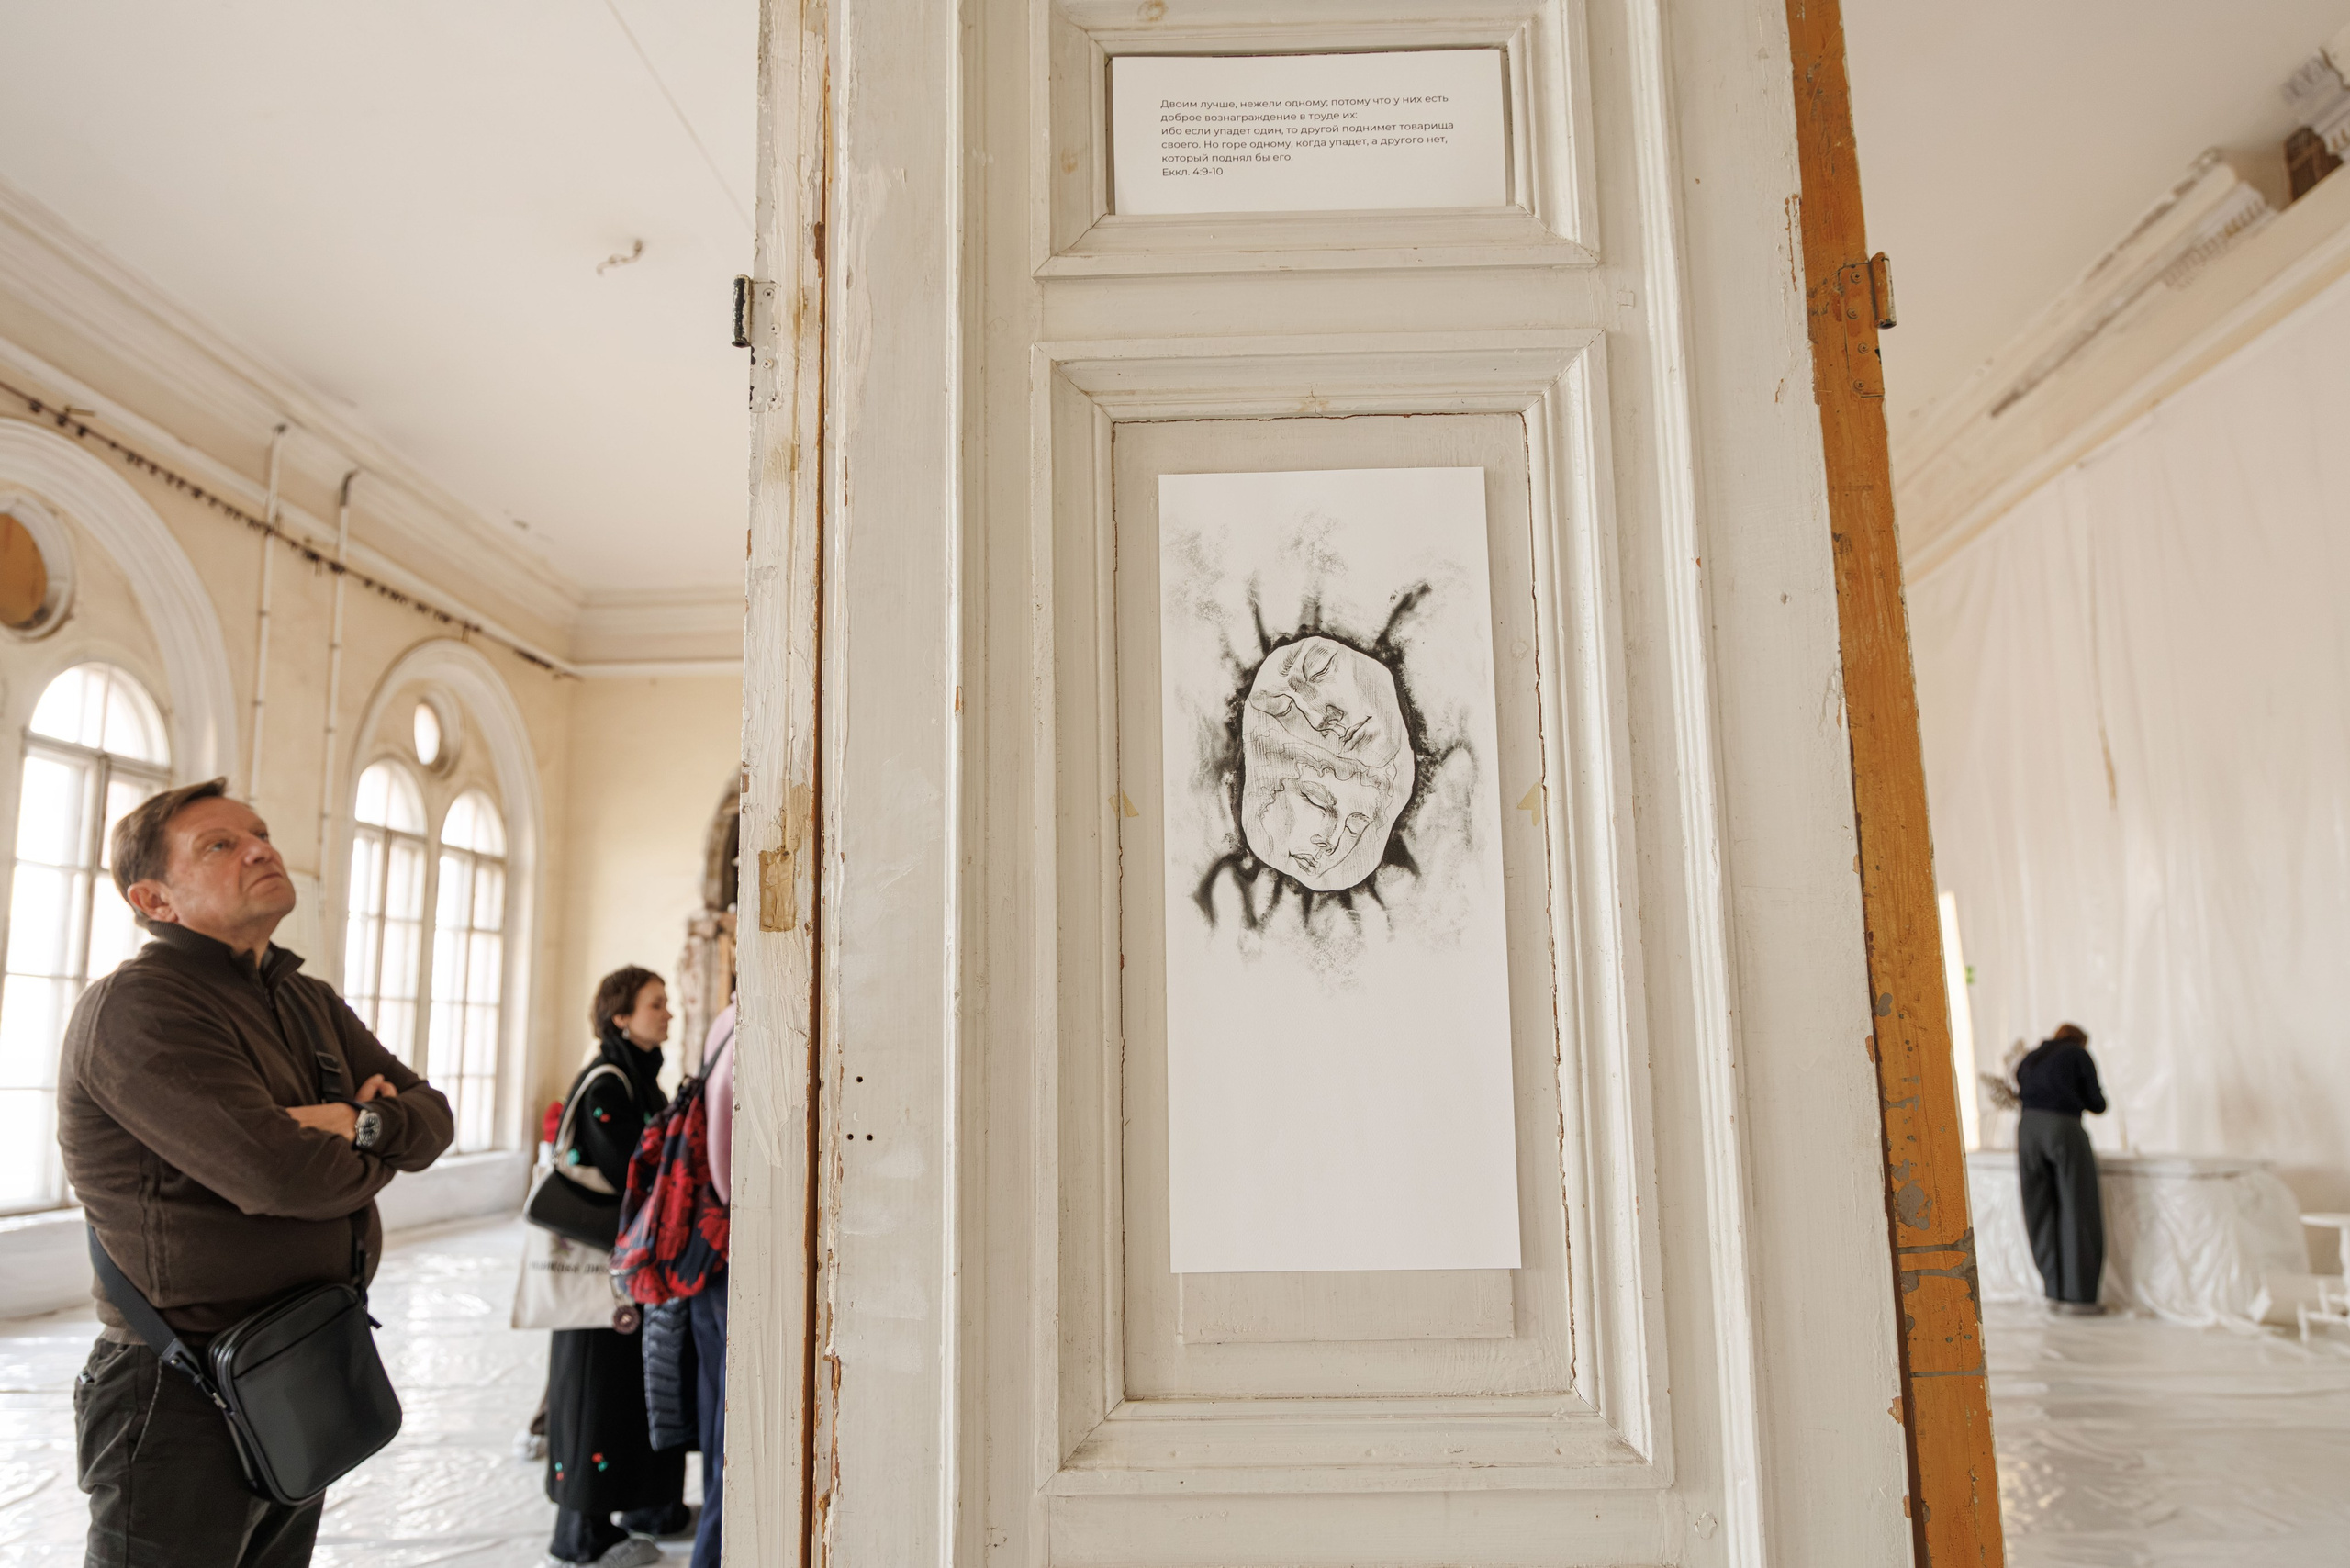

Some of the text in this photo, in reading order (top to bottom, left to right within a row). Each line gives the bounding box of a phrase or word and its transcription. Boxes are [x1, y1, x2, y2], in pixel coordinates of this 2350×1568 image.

[1159, 99, 1198, 110] Двоим
[1200, 101, 1238, 111] лучше,
[1239, 100, 1282, 108] нежели
[1284, 99, 1329, 109] одному;
[1330, 98, 1371, 107] потому
[1393, 96, 1401, 106] у
[1424, 95, 1449, 104] есть
[1159, 111, 1358, 124] доброе вознаграждение в труде их:
[1161, 122, 1454, 138] ибо если упадет один, то другой поднимет товарища
[1160, 136, 1449, 151] своего. Но горе одному, когда упадет, а другого нет,
[1161, 152, 1293, 164] который поднял бы его.
[1161, 166, 1224, 177] Еккл. 4:9-10
